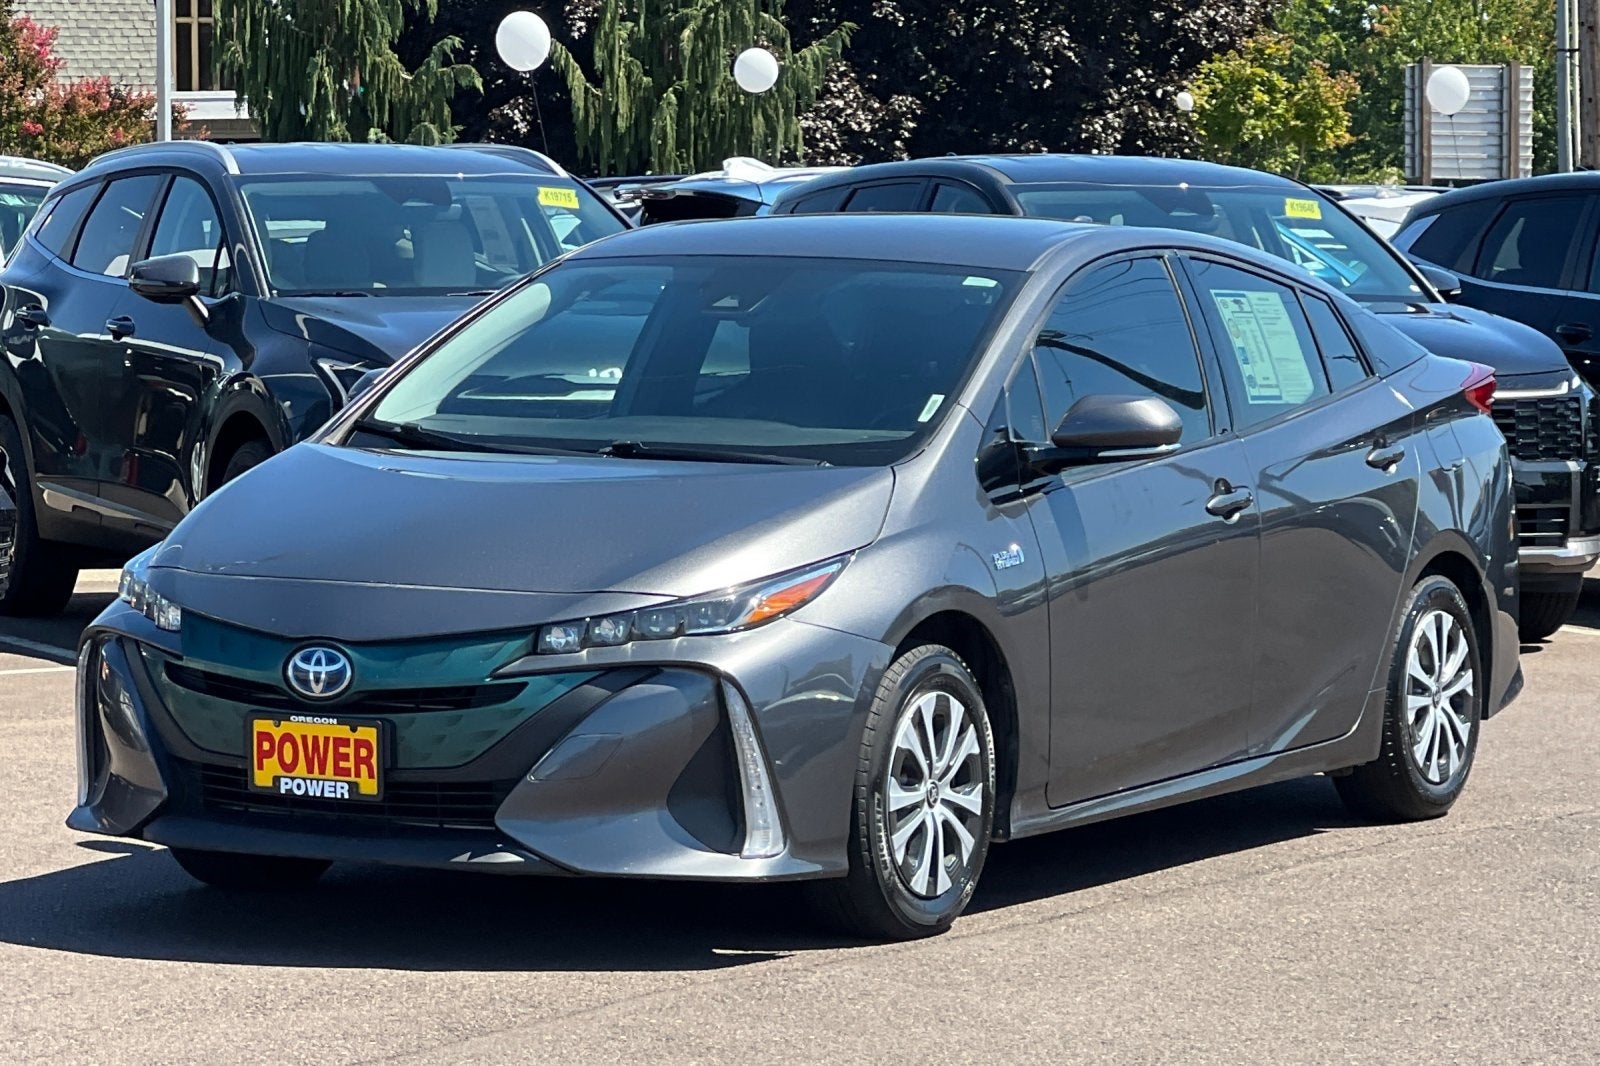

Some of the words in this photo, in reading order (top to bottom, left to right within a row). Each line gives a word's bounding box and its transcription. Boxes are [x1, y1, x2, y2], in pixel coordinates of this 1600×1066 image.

[289, 715, 338, 725] OREGON
[256, 731, 376, 780] POWER
[280, 777, 350, 799] POWER
